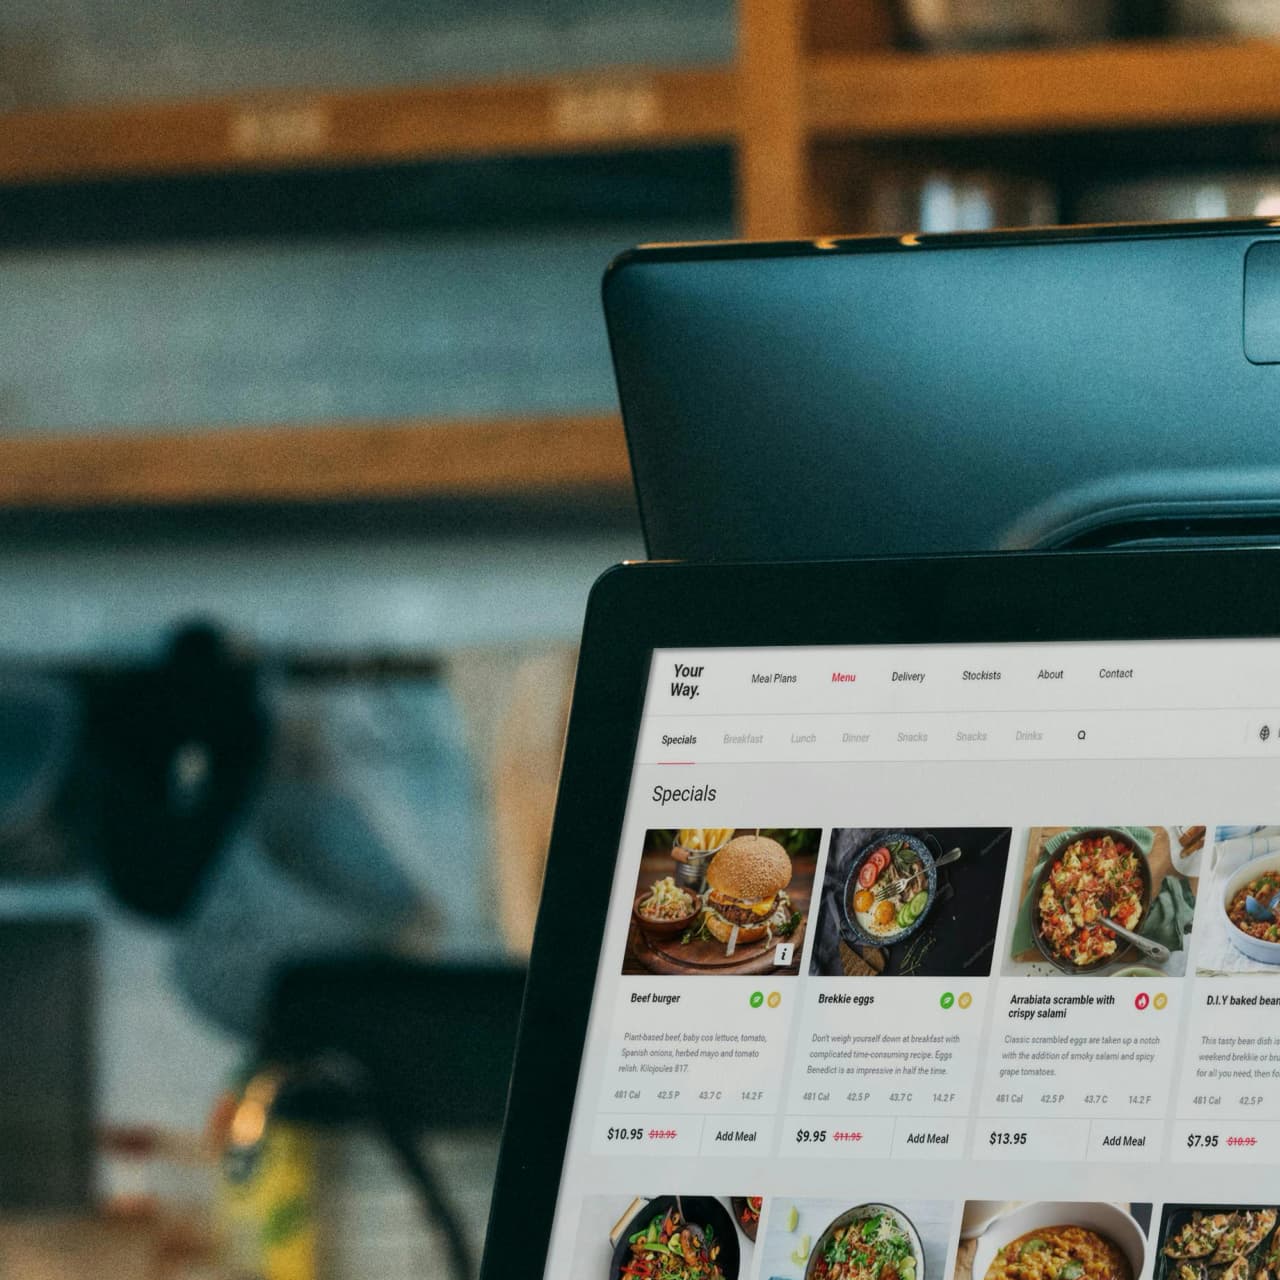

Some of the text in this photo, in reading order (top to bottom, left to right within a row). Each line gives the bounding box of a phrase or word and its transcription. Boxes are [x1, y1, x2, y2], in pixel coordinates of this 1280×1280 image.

[673, 663, 704, 678] Your
[831, 672, 856, 682] Menu
[890, 670, 926, 684] Delivery
[961, 669, 1002, 681] Stockists
[1036, 668, 1064, 680] About
[1098, 667, 1133, 679] Contact
[750, 672, 797, 684] Meal Plans
[670, 681, 700, 699] Way.
[660, 734, 697, 747] Specials
[722, 732, 764, 744] Breakfast
[790, 732, 817, 744] Lunch
[841, 732, 870, 743] Dinner
[896, 731, 928, 742] Snacks
[955, 730, 988, 742] Snacks
[1014, 729, 1043, 741] Drinks
[651, 783, 717, 806] Specials
[629, 992, 681, 1005] Beef burger
[817, 992, 875, 1006] Brekkie eggs
[1009, 993, 1115, 1005] Arrabiata scramble with
[1205, 994, 1229, 1006] D.I.Y
[1228, 994, 1258, 1006] baked
[1007, 1007, 1067, 1020] crispy salami
[623, 1031, 665, 1042] Plant-based
[682, 1032, 700, 1044] baby
[699, 1034, 714, 1042] cos
[830, 1032, 852, 1045] weigh
[851, 1033, 882, 1045] yourself
[880, 1033, 901, 1043] down
[901, 1034, 910, 1043] at
[910, 1033, 944, 1044] breakfast
[944, 1033, 960, 1044] with
[1003, 1034, 1160, 1047] Classic scrambled eggs are taken up a notch
[1201, 1035, 1217, 1045] This
[1217, 1036, 1237, 1048] tasty
[1236, 1035, 1256, 1046] bean
[1255, 1035, 1273, 1046] dish
[1272, 1037, 1280, 1046] is
[620, 1047, 648, 1059] Spanish
[674, 1047, 700, 1057] herbed
[698, 1050, 720, 1060] mayo
[719, 1048, 734, 1058] and
[733, 1049, 760, 1058] tomato
[808, 1049, 853, 1061] complicated
[852, 1050, 909, 1062] time-consuming
[934, 1049, 953, 1062] Eggs
[1001, 1050, 1155, 1063] with the addition of smoky salami and spicy
[1198, 1051, 1232, 1062] weekend
[1230, 1051, 1259, 1062] brekkie
[1258, 1054, 1268, 1062] or
[639, 1063, 674, 1076] Kilojoules
[805, 1064, 837, 1074] Benedict
[837, 1065, 845, 1075] is
[855, 1066, 894, 1077] impressive
[893, 1065, 902, 1075] in
[901, 1065, 917, 1075] half
[916, 1065, 929, 1075] the
[998, 1068, 1020, 1078] grape
[1195, 1067, 1208, 1077] for
[1207, 1067, 1218, 1077] all
[1217, 1070, 1232, 1080] you
[1253, 1068, 1271, 1078] then
[606, 1126, 644, 1141] $10.95
[714, 1130, 757, 1142] Add Meal
[795, 1128, 827, 1143] $9.95
[906, 1132, 949, 1144] Add Meal
[988, 1130, 1027, 1145] $13.95
[1101, 1135, 1146, 1147] Add Meal
[1186, 1133, 1219, 1148] $7.95
